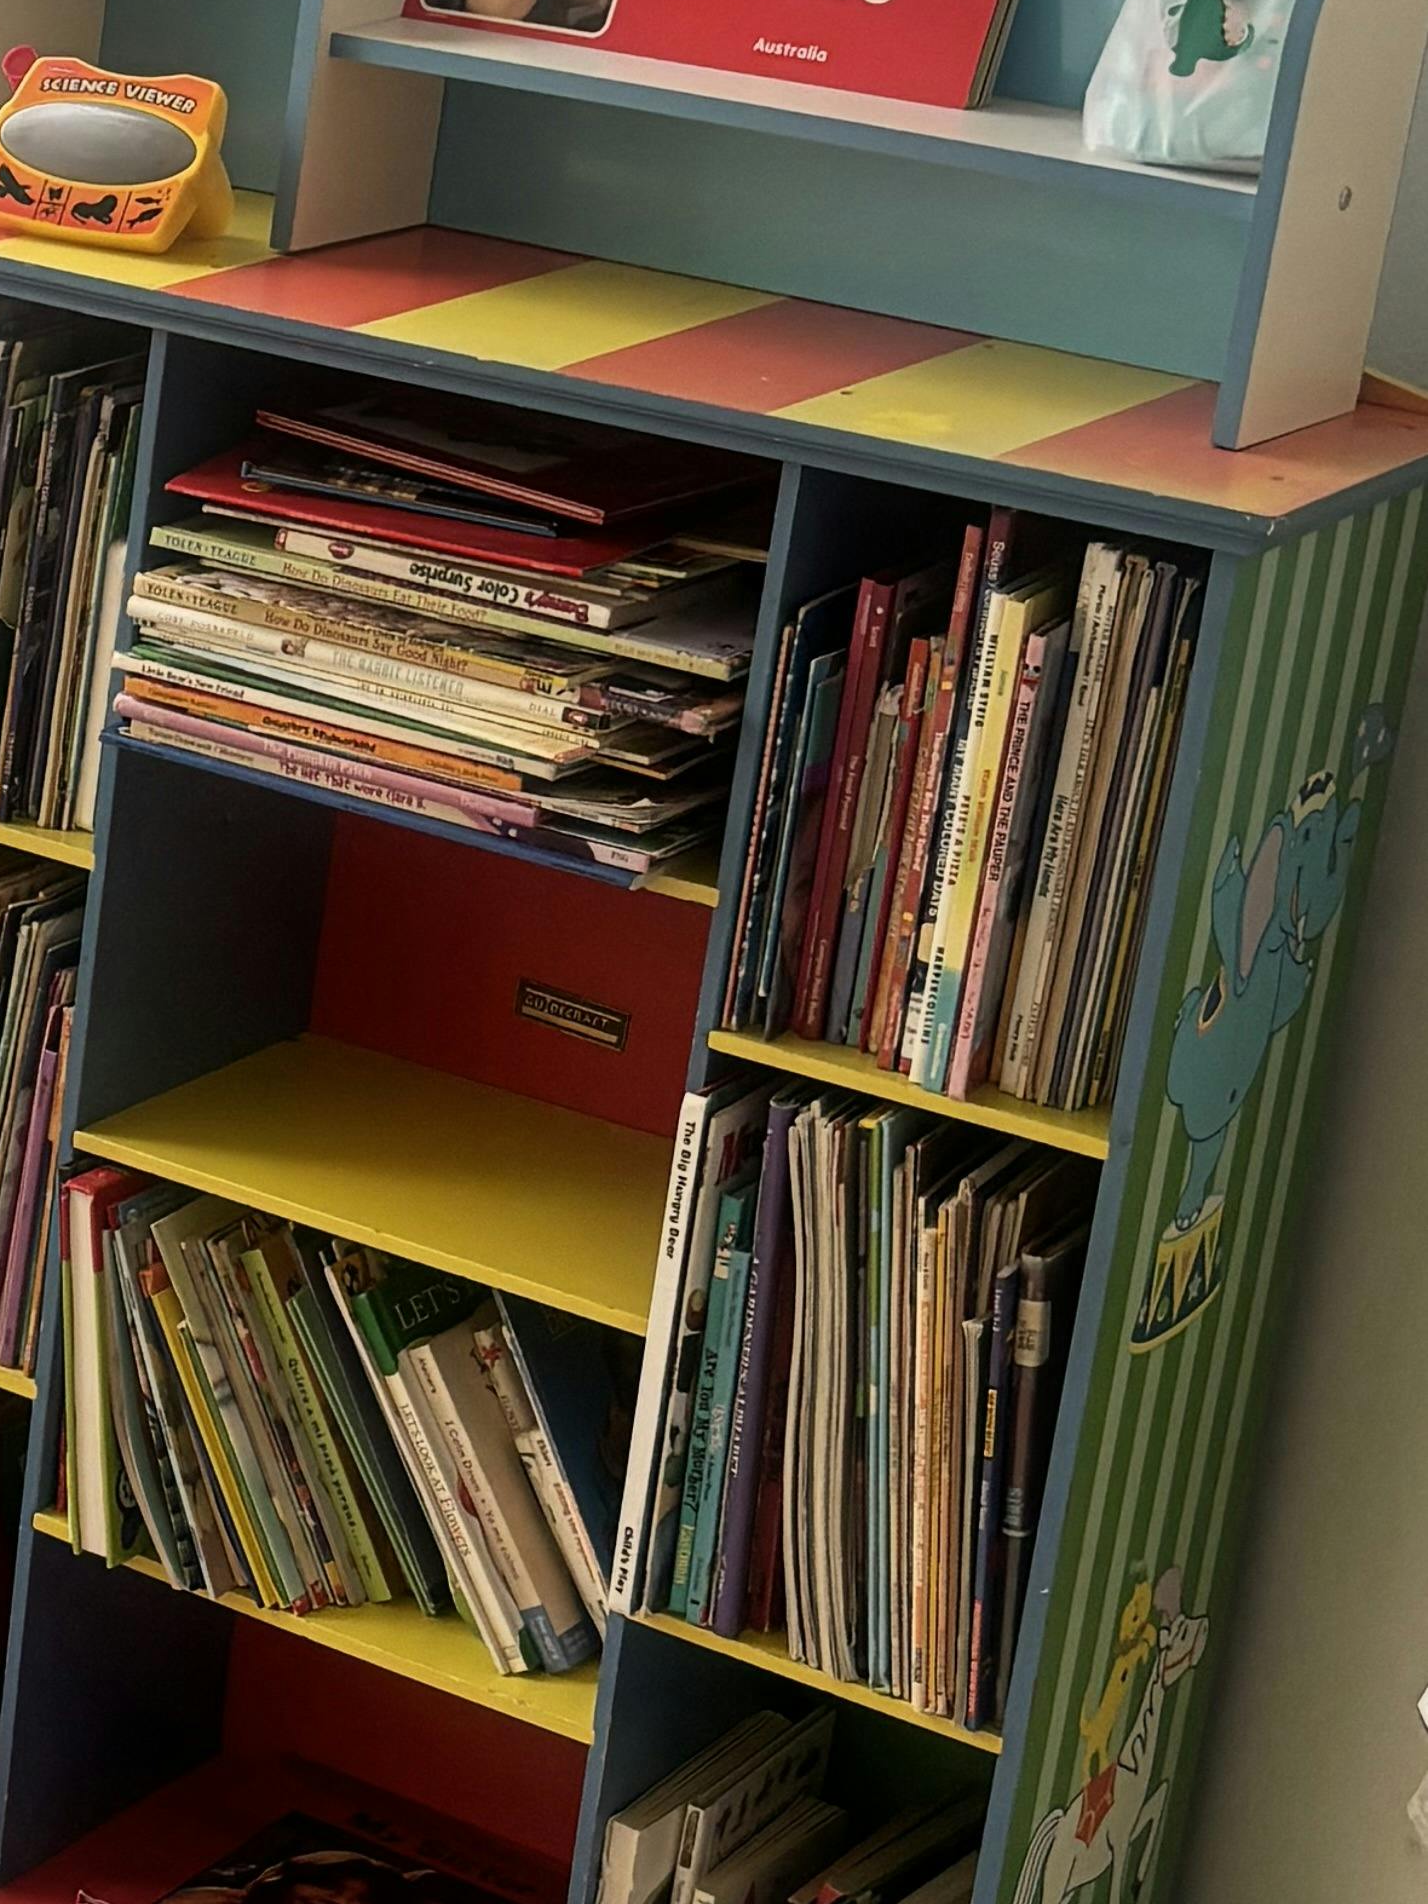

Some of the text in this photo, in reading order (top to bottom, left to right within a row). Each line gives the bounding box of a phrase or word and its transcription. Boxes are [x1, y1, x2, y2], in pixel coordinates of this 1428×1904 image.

[753, 38, 828, 63] Australia
[41, 77, 197, 114] SCIENCE VIEWER
[164, 533, 487, 623] YOLEN TEAGUE How Do Dinosaurs Eat Their Food?
[407, 556, 474, 595] Surprise
[987, 540, 1004, 581] Seuss
[475, 578, 520, 606] Color
[1094, 584, 1106, 613] Martin
[145, 582, 468, 674] YOLEN TEAGUE How Do Dinosaurs Say Good Night?
[980, 633, 998, 687] WILLIAM
[141, 663, 164, 676] Little
[166, 670, 193, 684] Bear's
[215, 682, 244, 698] Friend
[331, 648, 355, 668] THE
[357, 655, 402, 681] RABBIT
[403, 666, 464, 697] LISTENED
[528, 701, 556, 717] DIAL
[975, 692, 990, 728] STEIG
[276, 759, 299, 776] The
[324, 773, 352, 792] That
[988, 700, 1031, 881] THE PRINCE AND THE PAUPER
[928, 739, 966, 916] MY MANY COLORED DAYS
[956, 794, 971, 833] PETE'S
[954, 838, 964, 846] A
[1036, 794, 1068, 898] Here Are My Hands
[947, 850, 961, 886] PIZZA
[525, 995, 609, 1029] GUIDECRAFT
[682, 1120, 696, 1145] The
[676, 1148, 692, 1171] Big
[668, 1175, 687, 1223] Hungry
[395, 1280, 461, 1331] LET'S
[287, 1356, 311, 1404] Quiero
[306, 1407, 313, 1415] a
[311, 1419, 322, 1438] mi
[444, 1419, 454, 1427] I
[683, 1348, 722, 1511] Are You My Mother?
[448, 1428, 468, 1458] Calm
[399, 1403, 476, 1557] LET'S LOOK AT Flowers
[461, 1458, 483, 1493] Down
[550, 1481, 572, 1516] Eating
[620, 1526, 635, 1563] Child's
[614, 1566, 629, 1594] Play
